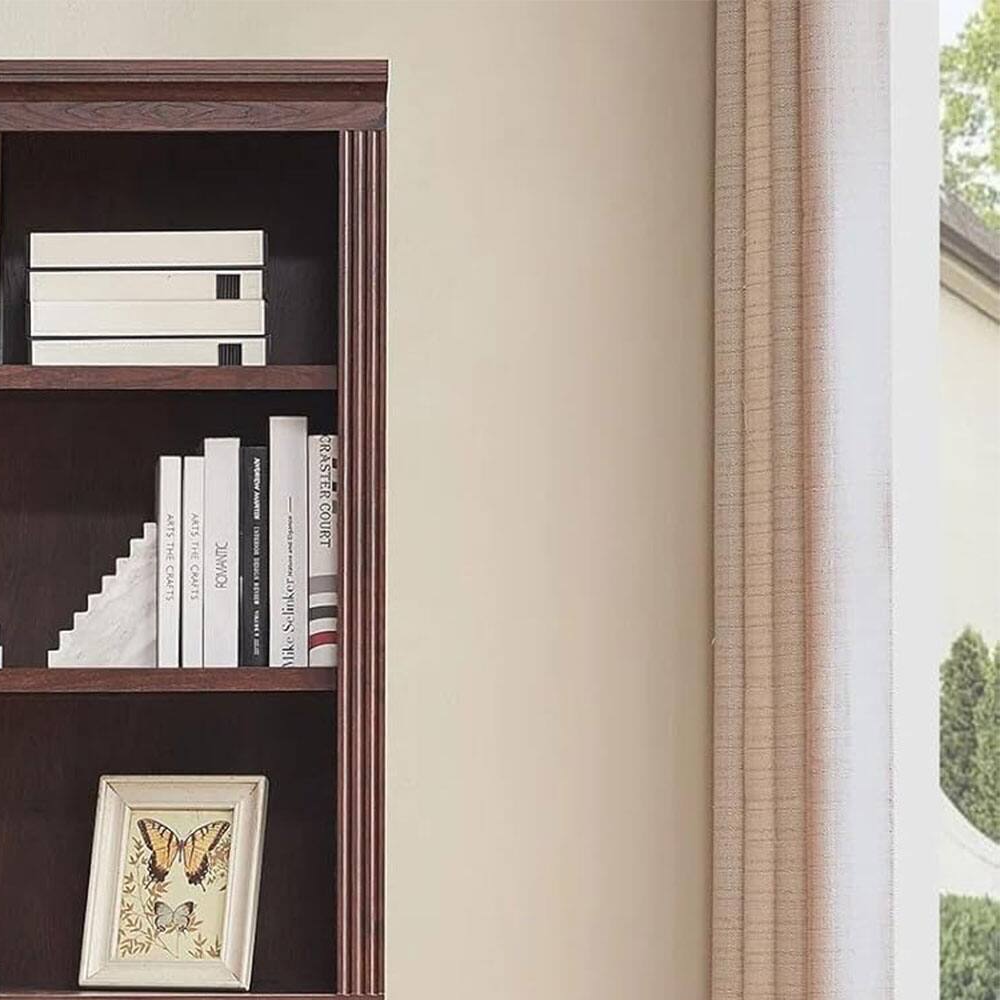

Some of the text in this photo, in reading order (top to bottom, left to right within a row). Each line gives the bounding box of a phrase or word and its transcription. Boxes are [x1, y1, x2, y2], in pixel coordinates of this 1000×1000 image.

[319, 435, 331, 548] CRASTER COURT
[165, 514, 174, 601] ARTS THE CRAFTS
[190, 513, 200, 600] ARTS THE CRAFTS
[216, 541, 228, 589] ROMANTIC
[281, 578, 295, 633] Selinker
